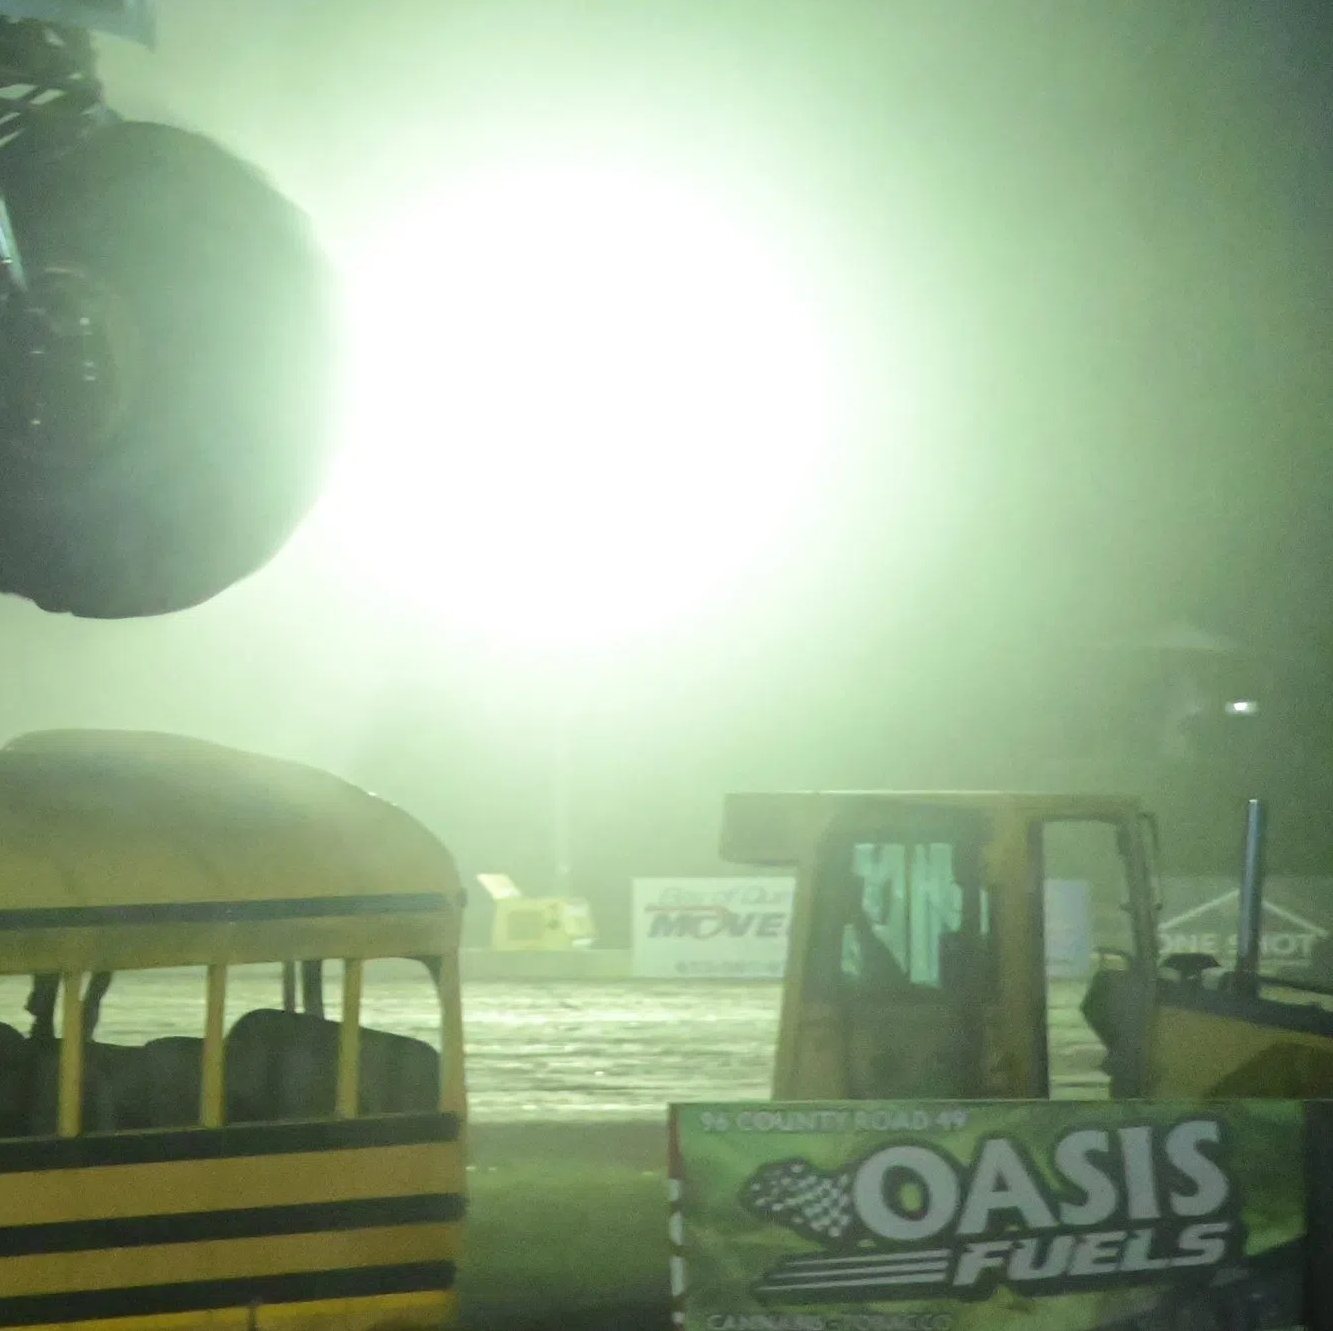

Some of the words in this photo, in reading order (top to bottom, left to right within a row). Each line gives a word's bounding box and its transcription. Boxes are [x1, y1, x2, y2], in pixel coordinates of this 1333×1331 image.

[647, 912, 790, 939] MOVE
[853, 1119, 1231, 1242] OASIS
[949, 1222, 1231, 1287] FUELS
